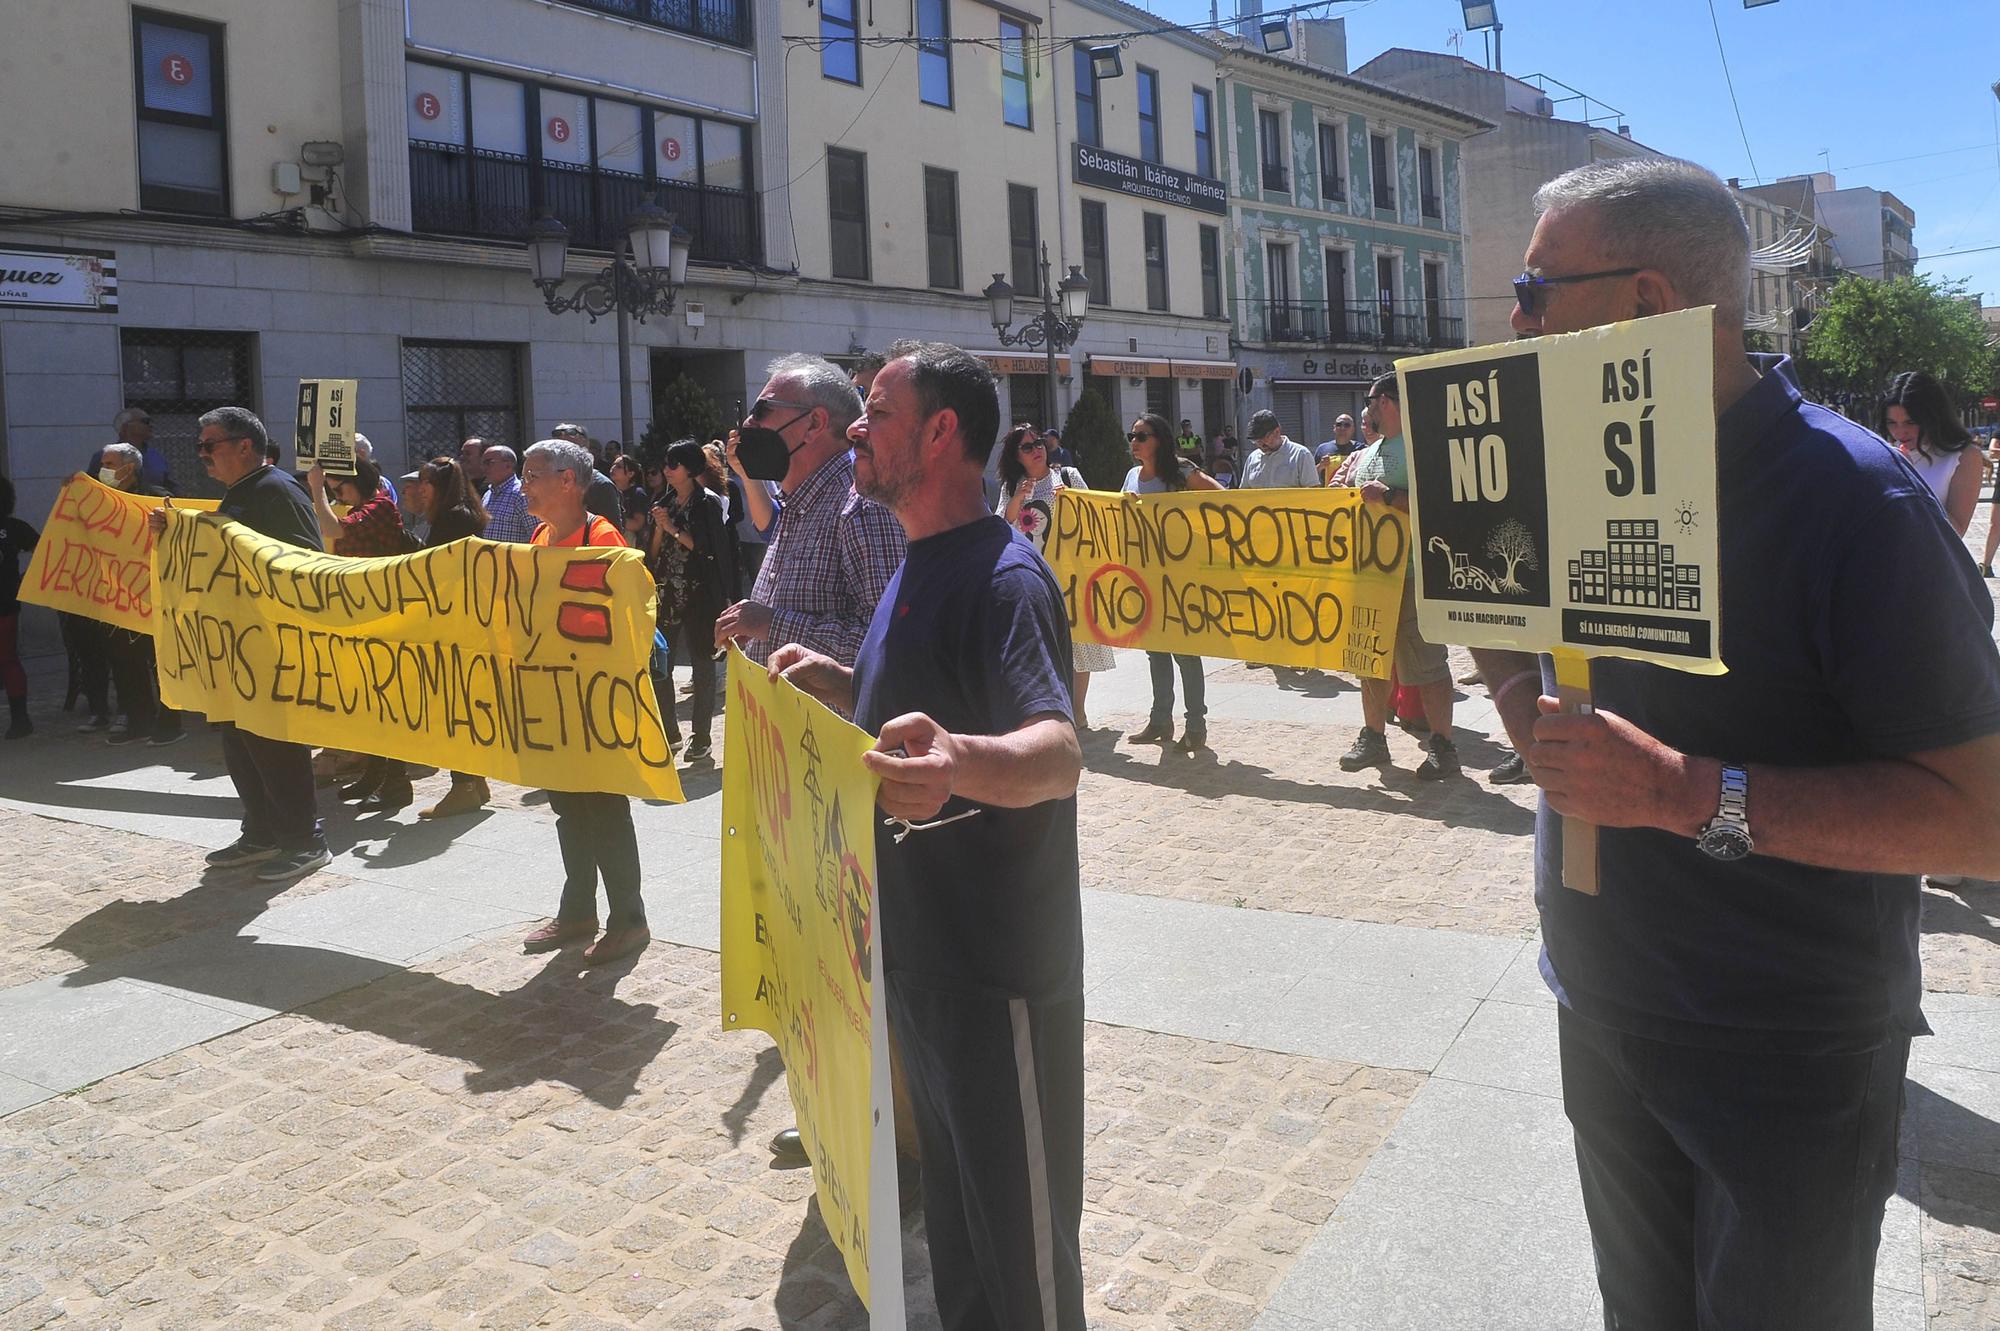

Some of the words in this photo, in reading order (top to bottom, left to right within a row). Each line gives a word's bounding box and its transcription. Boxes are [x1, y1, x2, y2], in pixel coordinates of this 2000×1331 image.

[1079, 148, 1138, 178] Sebastián
[1144, 165, 1179, 189] Ibáñez
[1184, 177, 1225, 201] Jiménez
[1122, 181, 1164, 198] ARQUITECTO
[1165, 190, 1191, 205] TÉCNICO
[1325, 358, 1336, 374] el
[1340, 359, 1369, 377] café
[1371, 362, 1382, 374] de
[1602, 348, 1653, 404] ASÍ
[303, 386, 313, 402] ASÍ
[330, 387, 343, 402] ASÍ
[1446, 369, 1501, 428] ASÍ
[301, 405, 312, 427] NO
[329, 404, 343, 428] SÍ
[1448, 434, 1508, 503] NO
[1603, 405, 1657, 498] SÍ
[1055, 494, 1194, 568] PANTANO
[1199, 501, 1405, 574] PROTEGIDO
[1092, 576, 1146, 630] NO
[1162, 574, 1343, 645] AGREDIDO
[1448, 610, 1457, 621] NO
[1458, 612, 1463, 621] A
[1463, 612, 1475, 623] LAS
[1475, 612, 1527, 627] MACROPLANTAS
[1579, 620, 1587, 634] SÍ
[1587, 622, 1594, 634] A
[1594, 623, 1604, 635] LA
[1604, 623, 1636, 638] ENERGÍA
[1637, 626, 1691, 645] COMUNITARIA
[163, 607, 263, 702] CAMPOS
[271, 622, 670, 768] ELECTROMAGNÉTICOS
